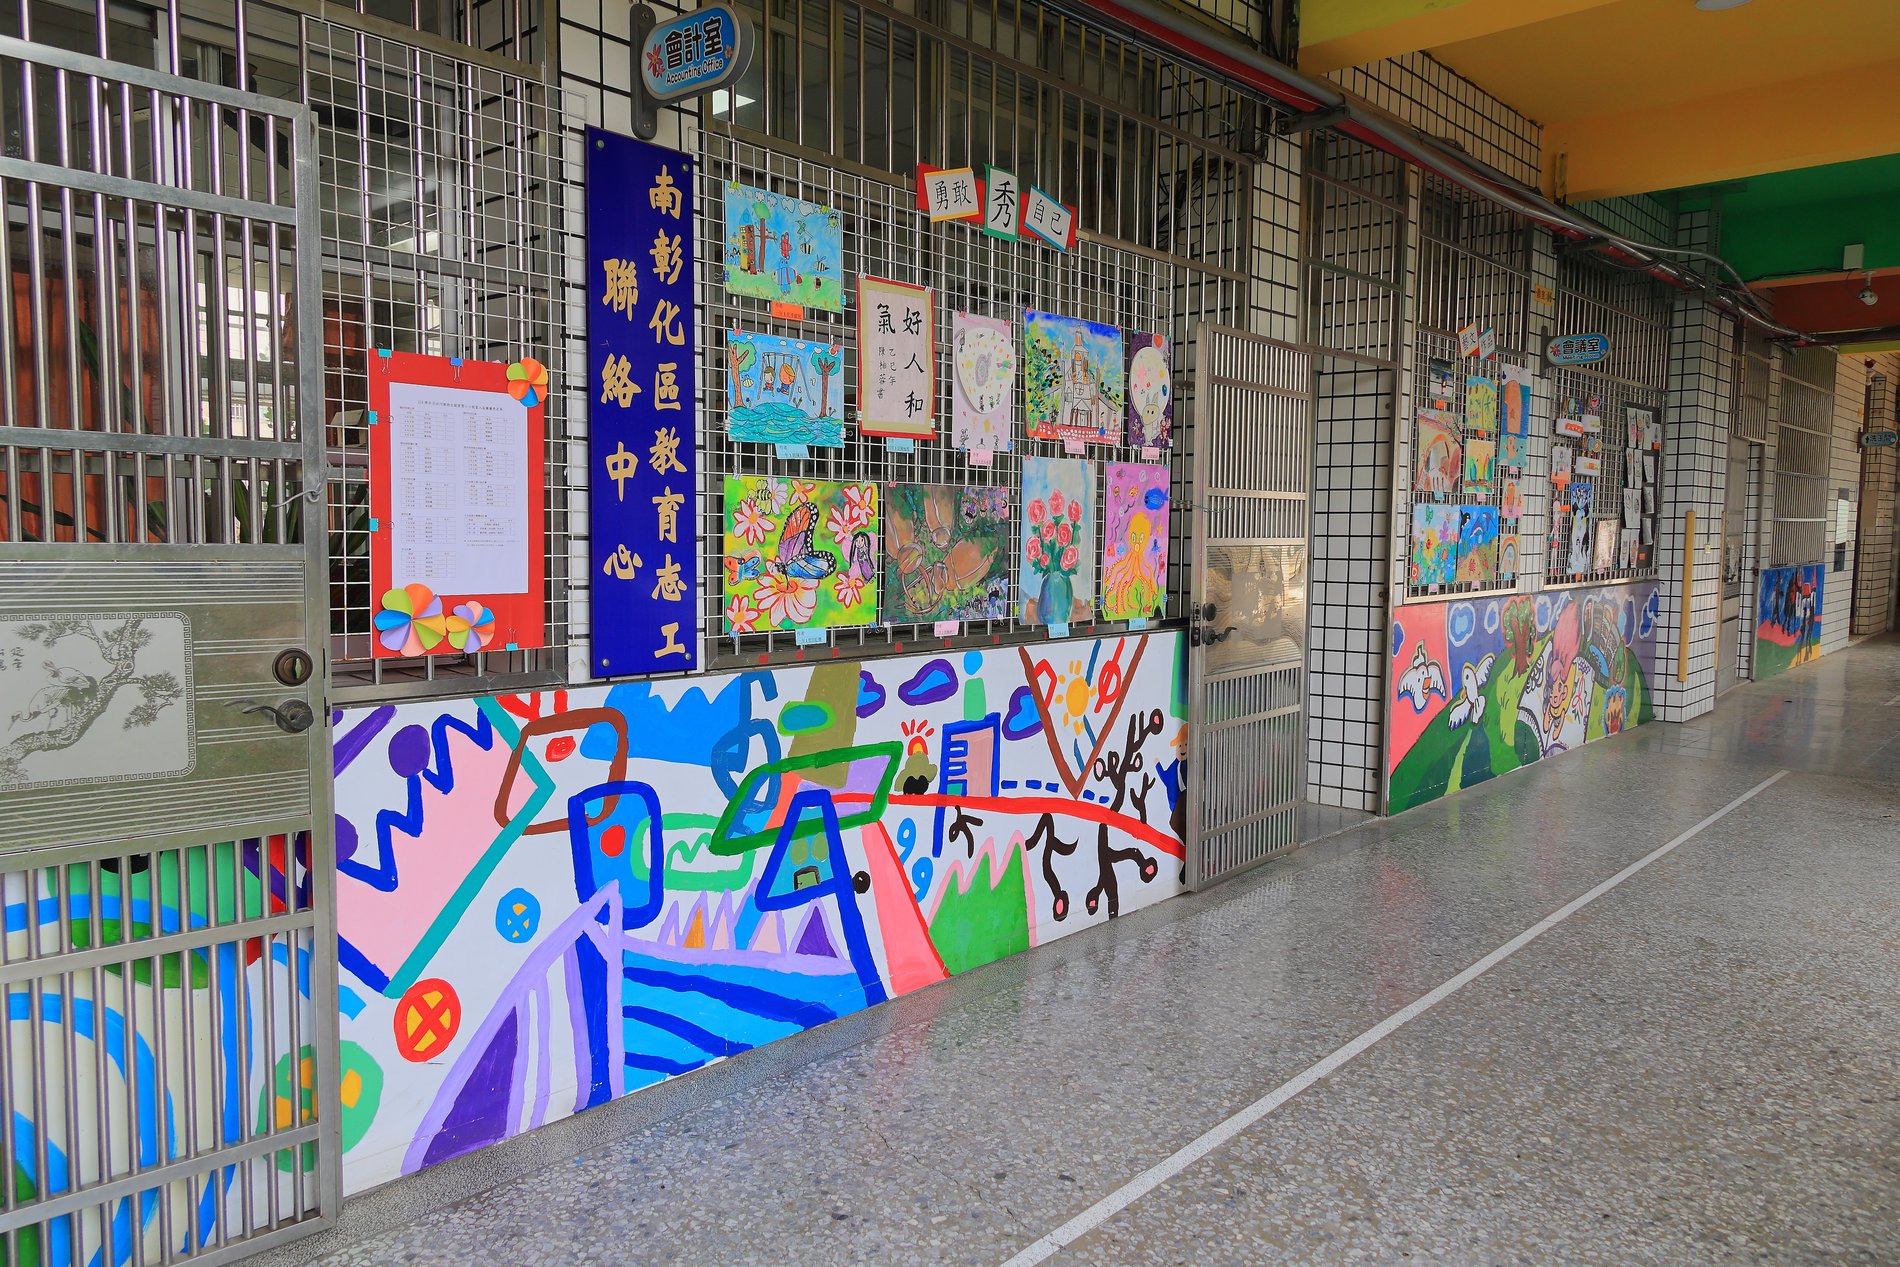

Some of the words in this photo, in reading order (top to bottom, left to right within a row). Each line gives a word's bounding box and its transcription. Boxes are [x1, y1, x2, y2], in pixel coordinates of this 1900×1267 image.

[664, 16, 723, 70] 會計室
[666, 65, 702, 86] Accounting
[703, 57, 724, 74] Office
[934, 179, 972, 212] 勇敢
[991, 180, 1015, 228] 秀
[1033, 199, 1062, 236] 自己
[1562, 338, 1600, 355] 會議室
[600, 258, 643, 580] 聯絡中心
[649, 164, 688, 658] 南彰化區教育志工
